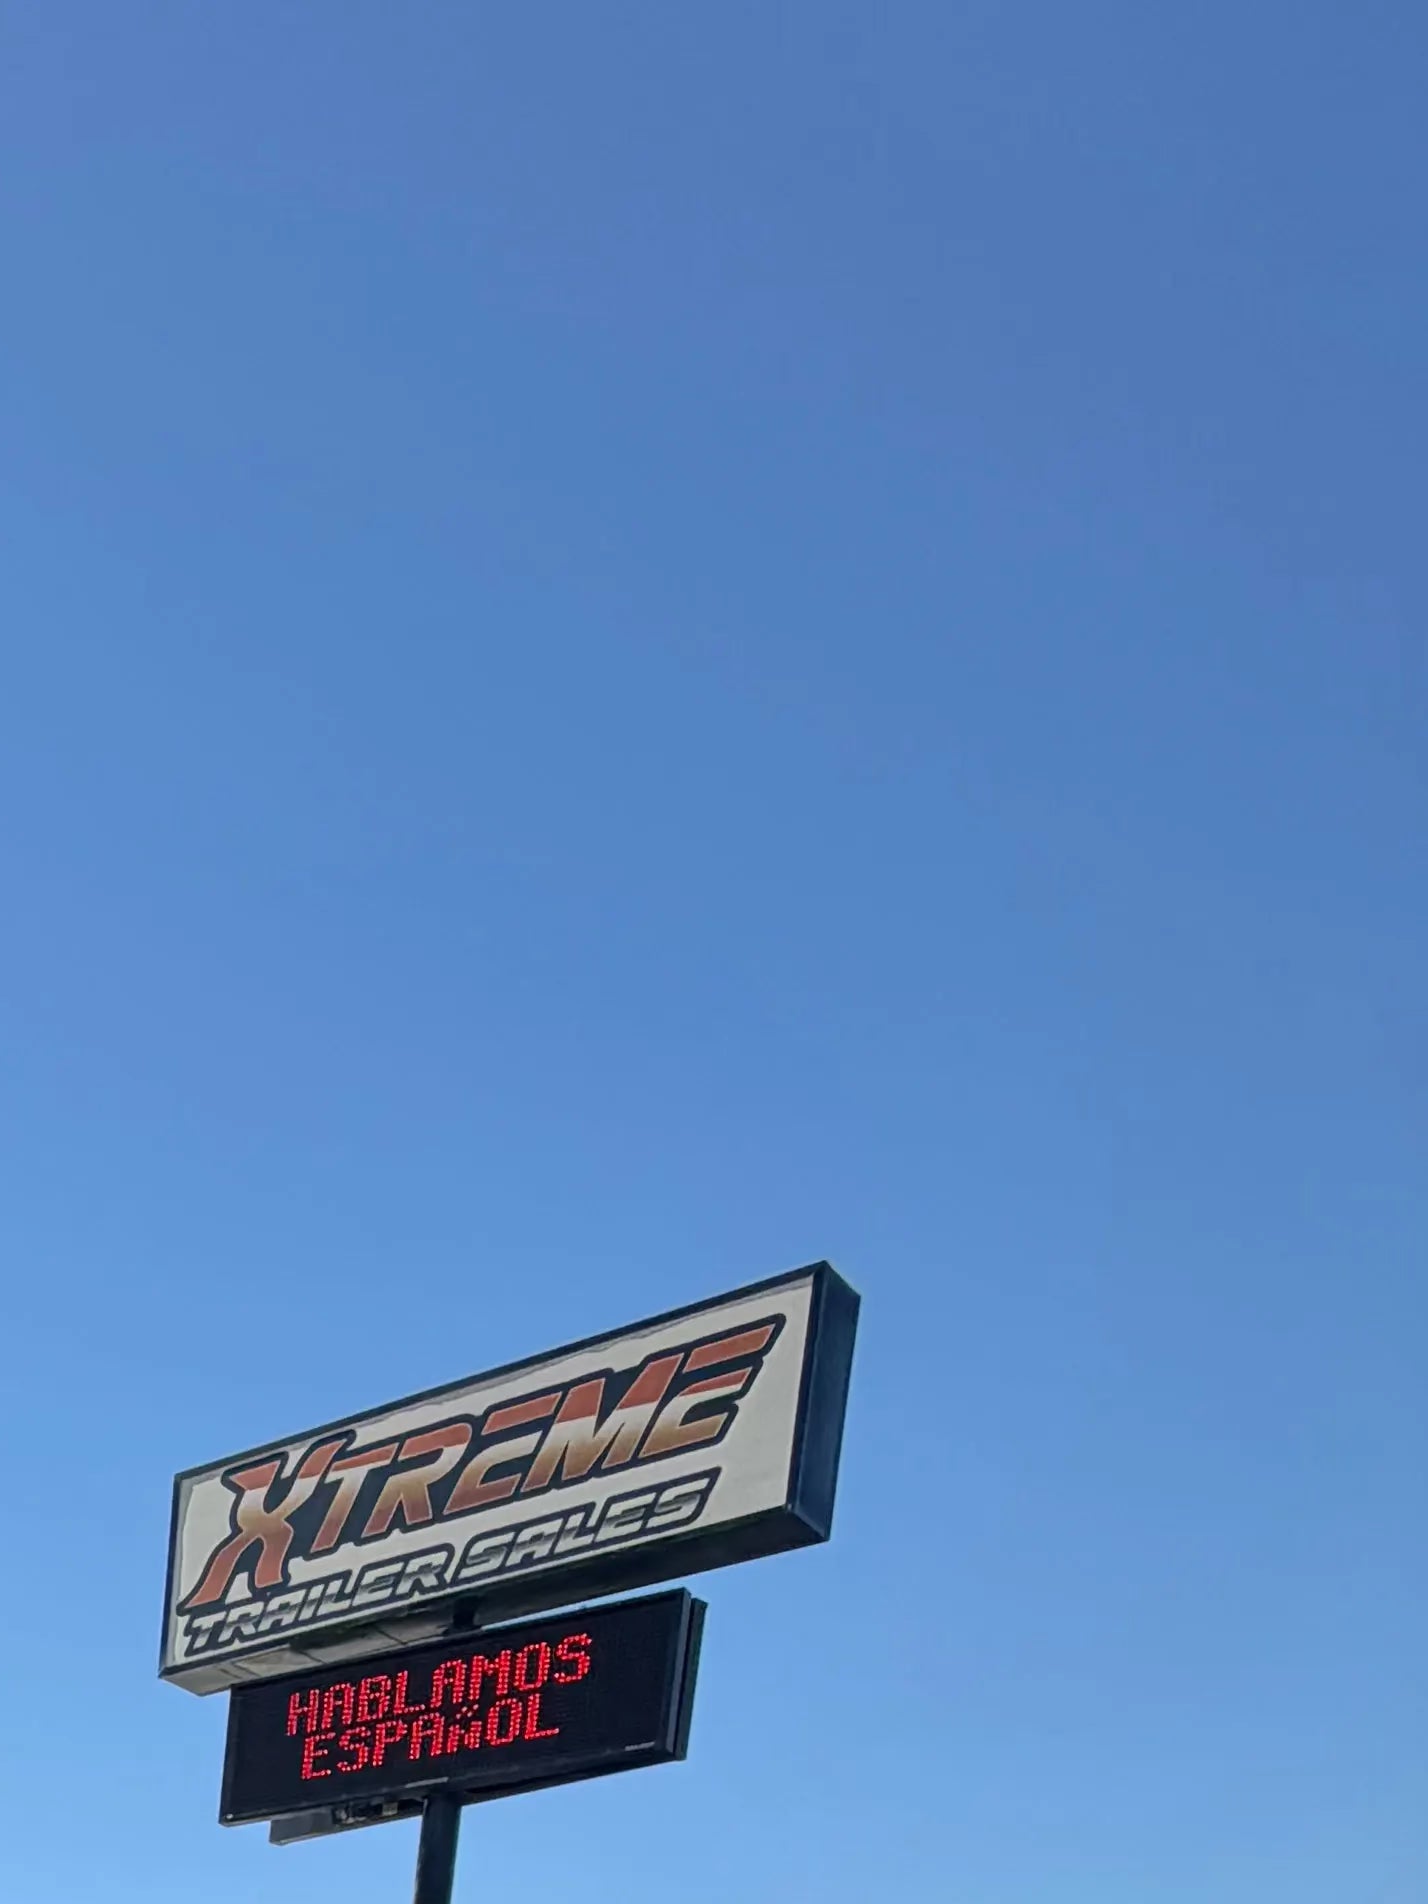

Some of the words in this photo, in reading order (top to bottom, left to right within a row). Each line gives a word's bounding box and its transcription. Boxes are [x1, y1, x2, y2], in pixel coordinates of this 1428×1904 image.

[184, 1324, 776, 1608] XTREME
[190, 1550, 449, 1643] TRAILER
[455, 1476, 712, 1580] SALES
[285, 1632, 593, 1737] HABLAMOS
[300, 1693, 560, 1780] ESPAÑOL
